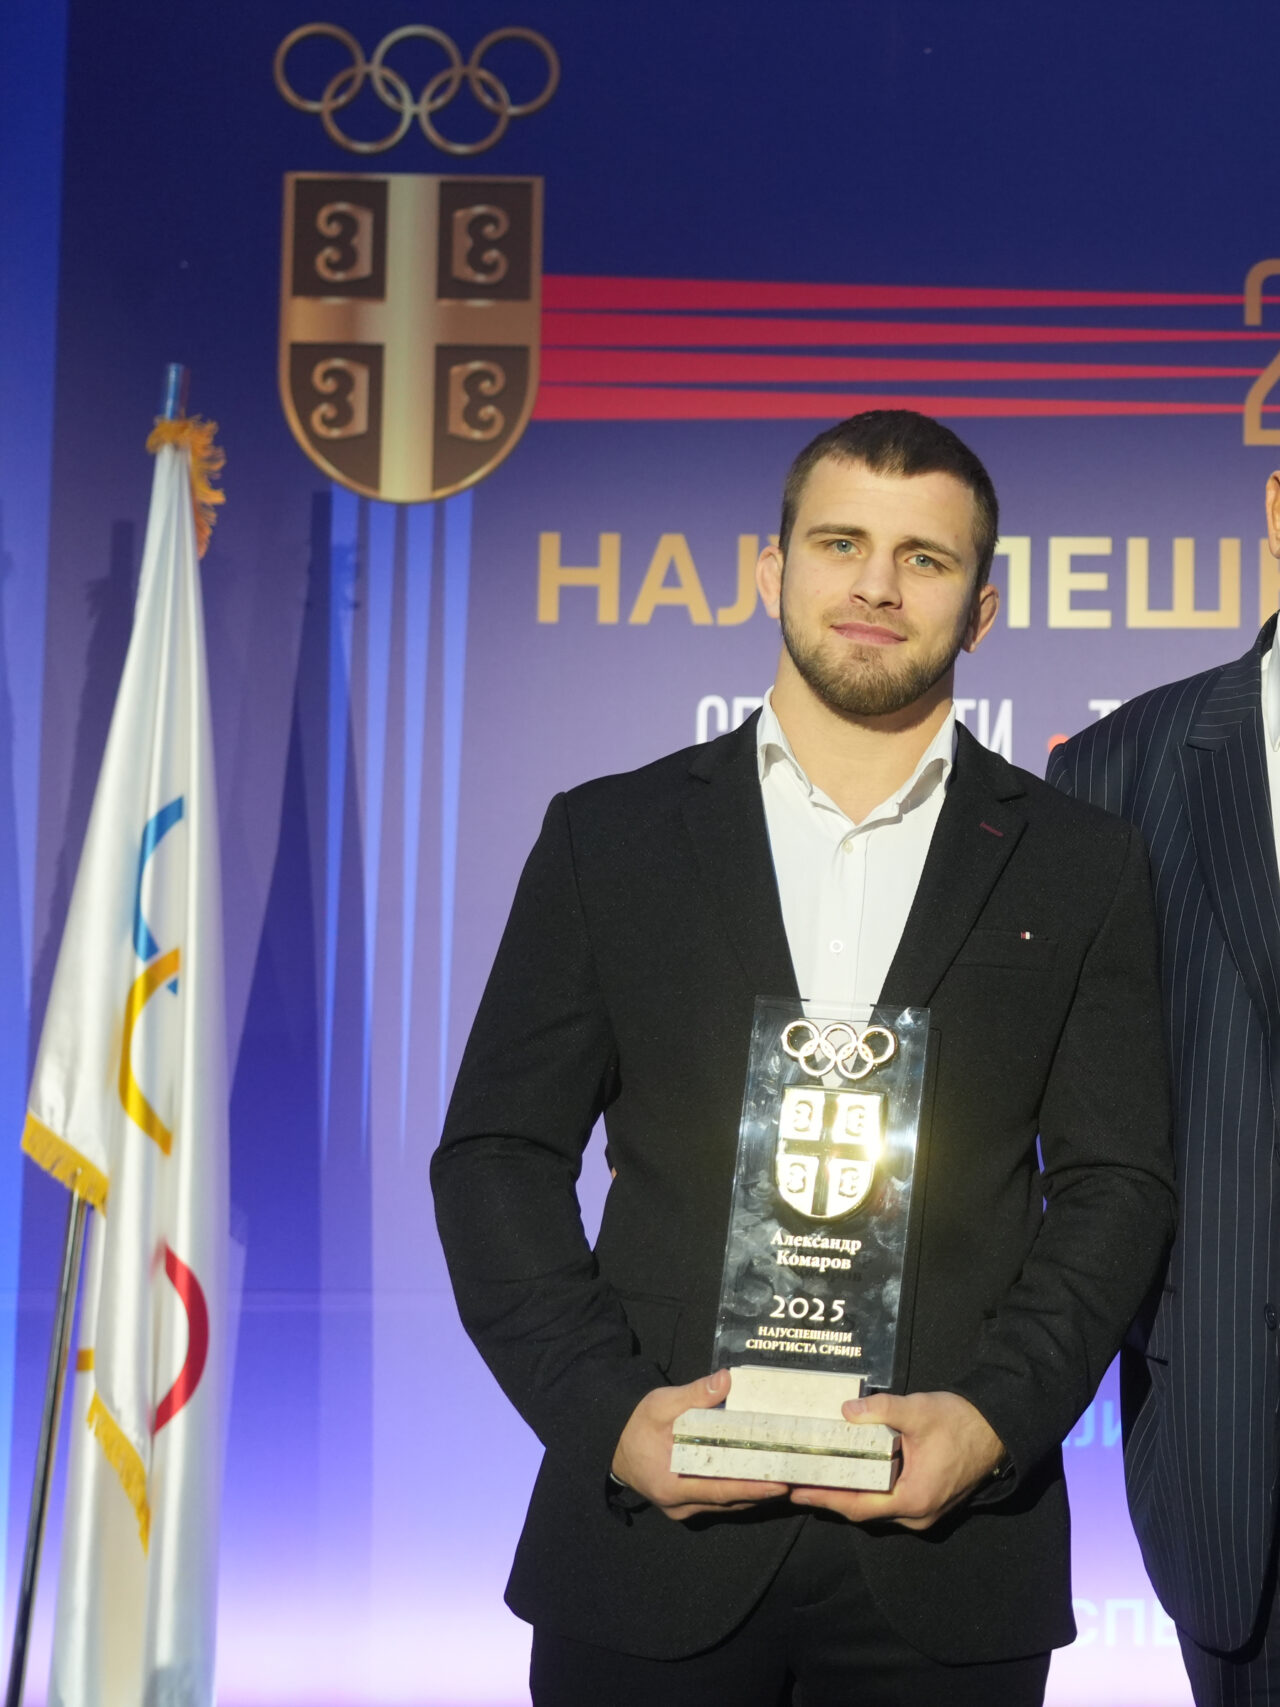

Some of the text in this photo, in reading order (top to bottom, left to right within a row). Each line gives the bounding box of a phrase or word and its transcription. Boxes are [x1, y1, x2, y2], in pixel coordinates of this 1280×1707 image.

[770, 1227, 862, 1256] Александр
[776, 1250, 852, 1272] Комаров
[769, 1294, 846, 1323] 2025
[758, 1326, 853, 1343] НАЈУСПЕШНИЈИ
[745, 1338, 862, 1358] СПОРТИСТА СРБИЈЕ
